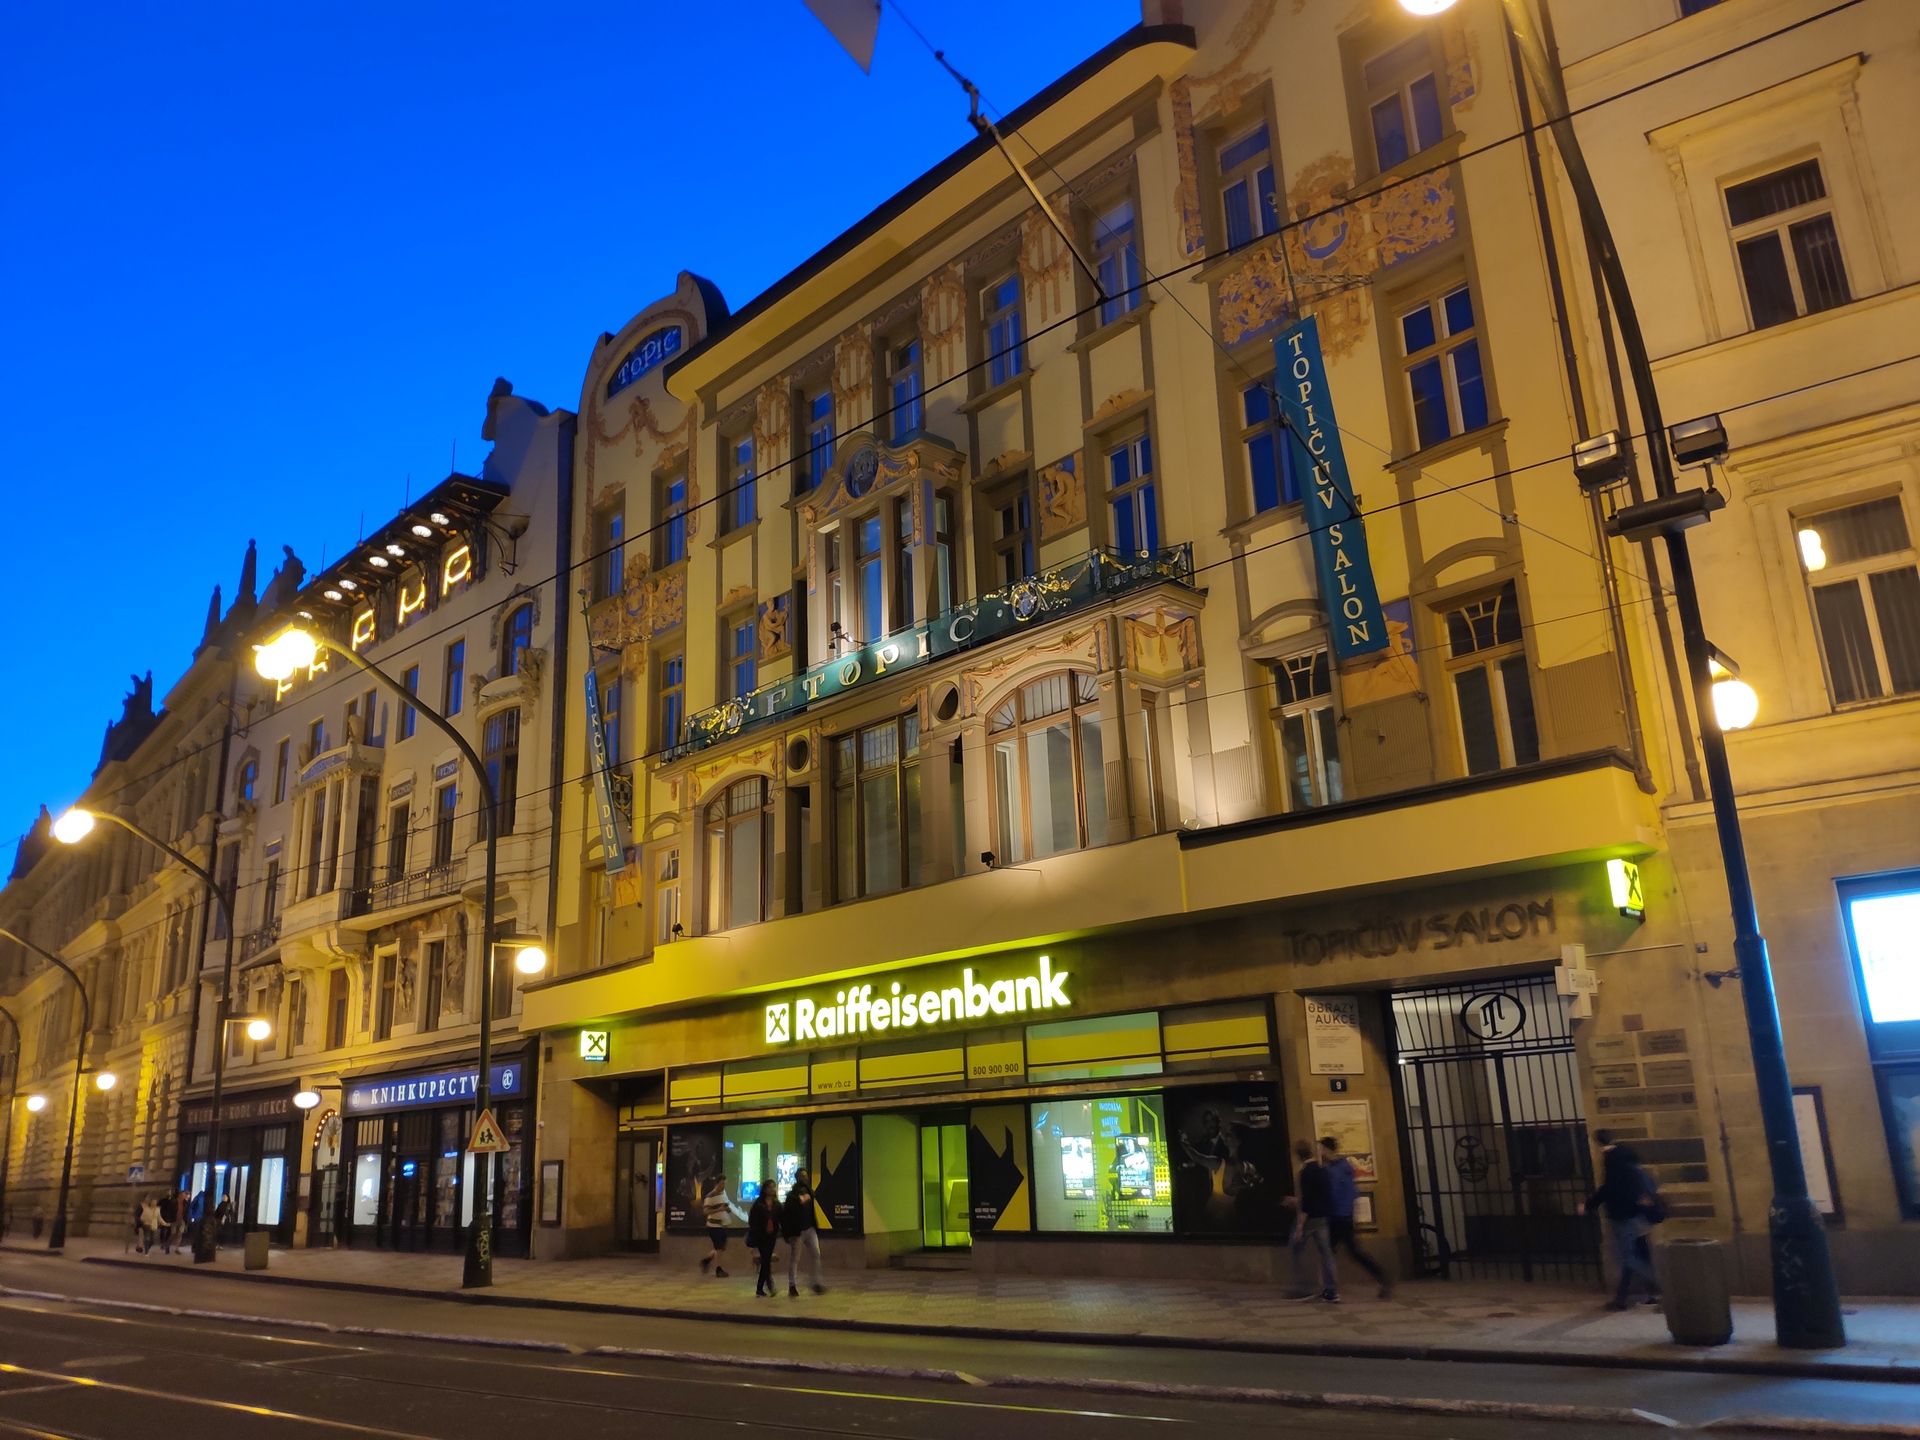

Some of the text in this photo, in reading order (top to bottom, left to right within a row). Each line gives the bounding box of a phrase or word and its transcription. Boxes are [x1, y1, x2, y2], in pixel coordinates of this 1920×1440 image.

[617, 328, 678, 385] TOPIČ
[1288, 332, 1370, 646] TOPIČŮV SALON
[802, 607, 980, 702] TOPIČ
[602, 804, 618, 859] DŮM
[1425, 897, 1557, 951] SALON
[795, 955, 1072, 1041] Raiffeisenbank
[1315, 1014, 1356, 1025] AUKCE
[371, 1075, 480, 1104] KNIHKUPECTV
[817, 1079, 851, 1091] www.rb.cz
[973, 1062, 1019, 1076] 800 900 900
[1335, 1081, 1342, 1090] 9
[257, 1099, 288, 1116] AUKCE
